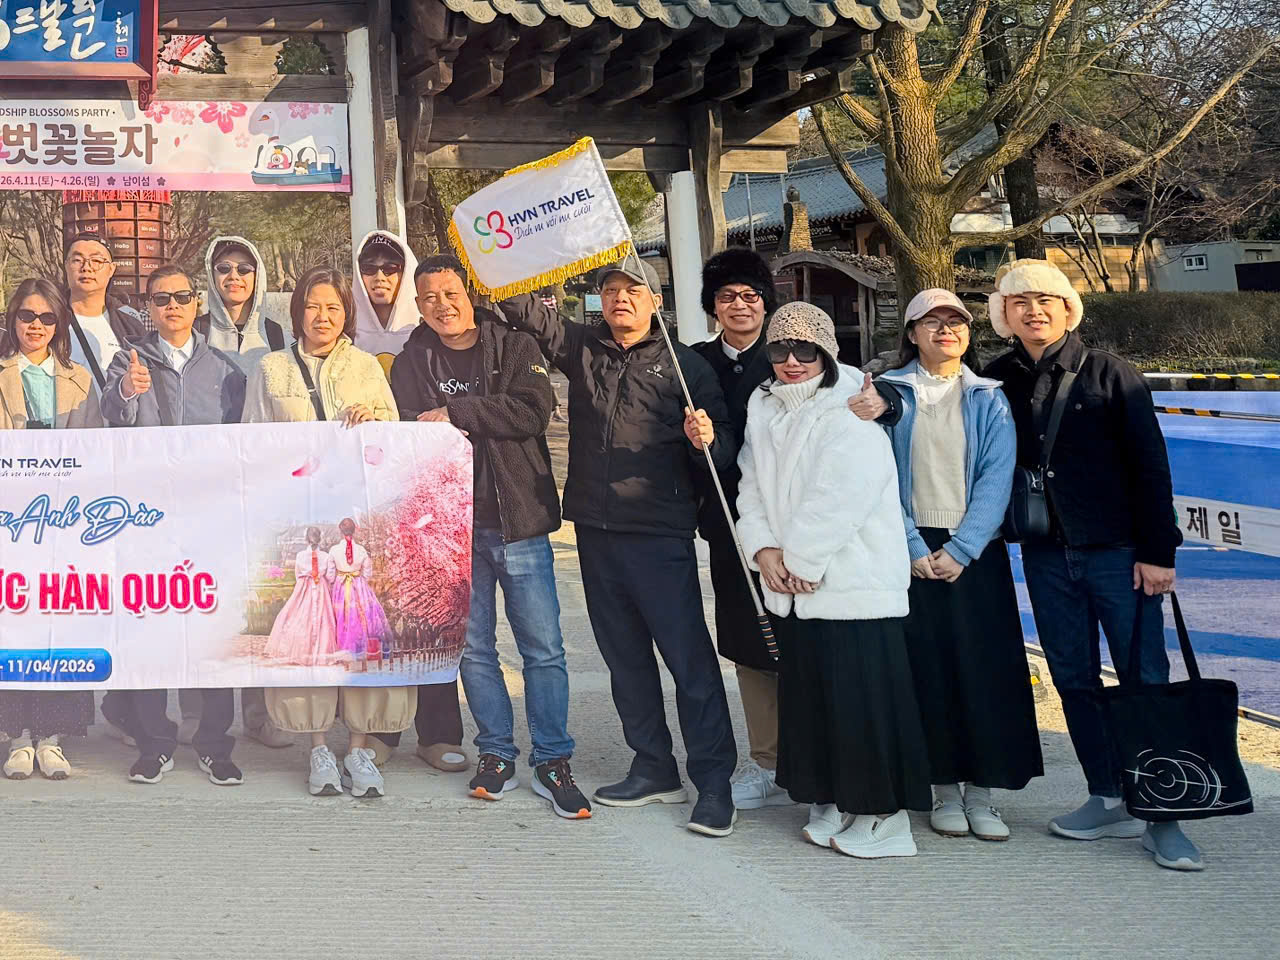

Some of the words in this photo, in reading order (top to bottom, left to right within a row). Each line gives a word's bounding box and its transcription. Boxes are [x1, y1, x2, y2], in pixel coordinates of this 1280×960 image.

[28, 108, 80, 117] BLOSSOMS
[81, 108, 111, 117] PARTY
[122, 176, 150, 187] 남이섬
[508, 206, 538, 227] HVN
[538, 188, 595, 215] TRAVEL
[16, 457, 82, 469] TRAVEL
[7, 494, 81, 546] Anh
[80, 496, 165, 546] Đào
[38, 564, 112, 611] HÀN
[121, 559, 218, 616] QUỐC
[6, 659, 96, 673] 11/04/2026
